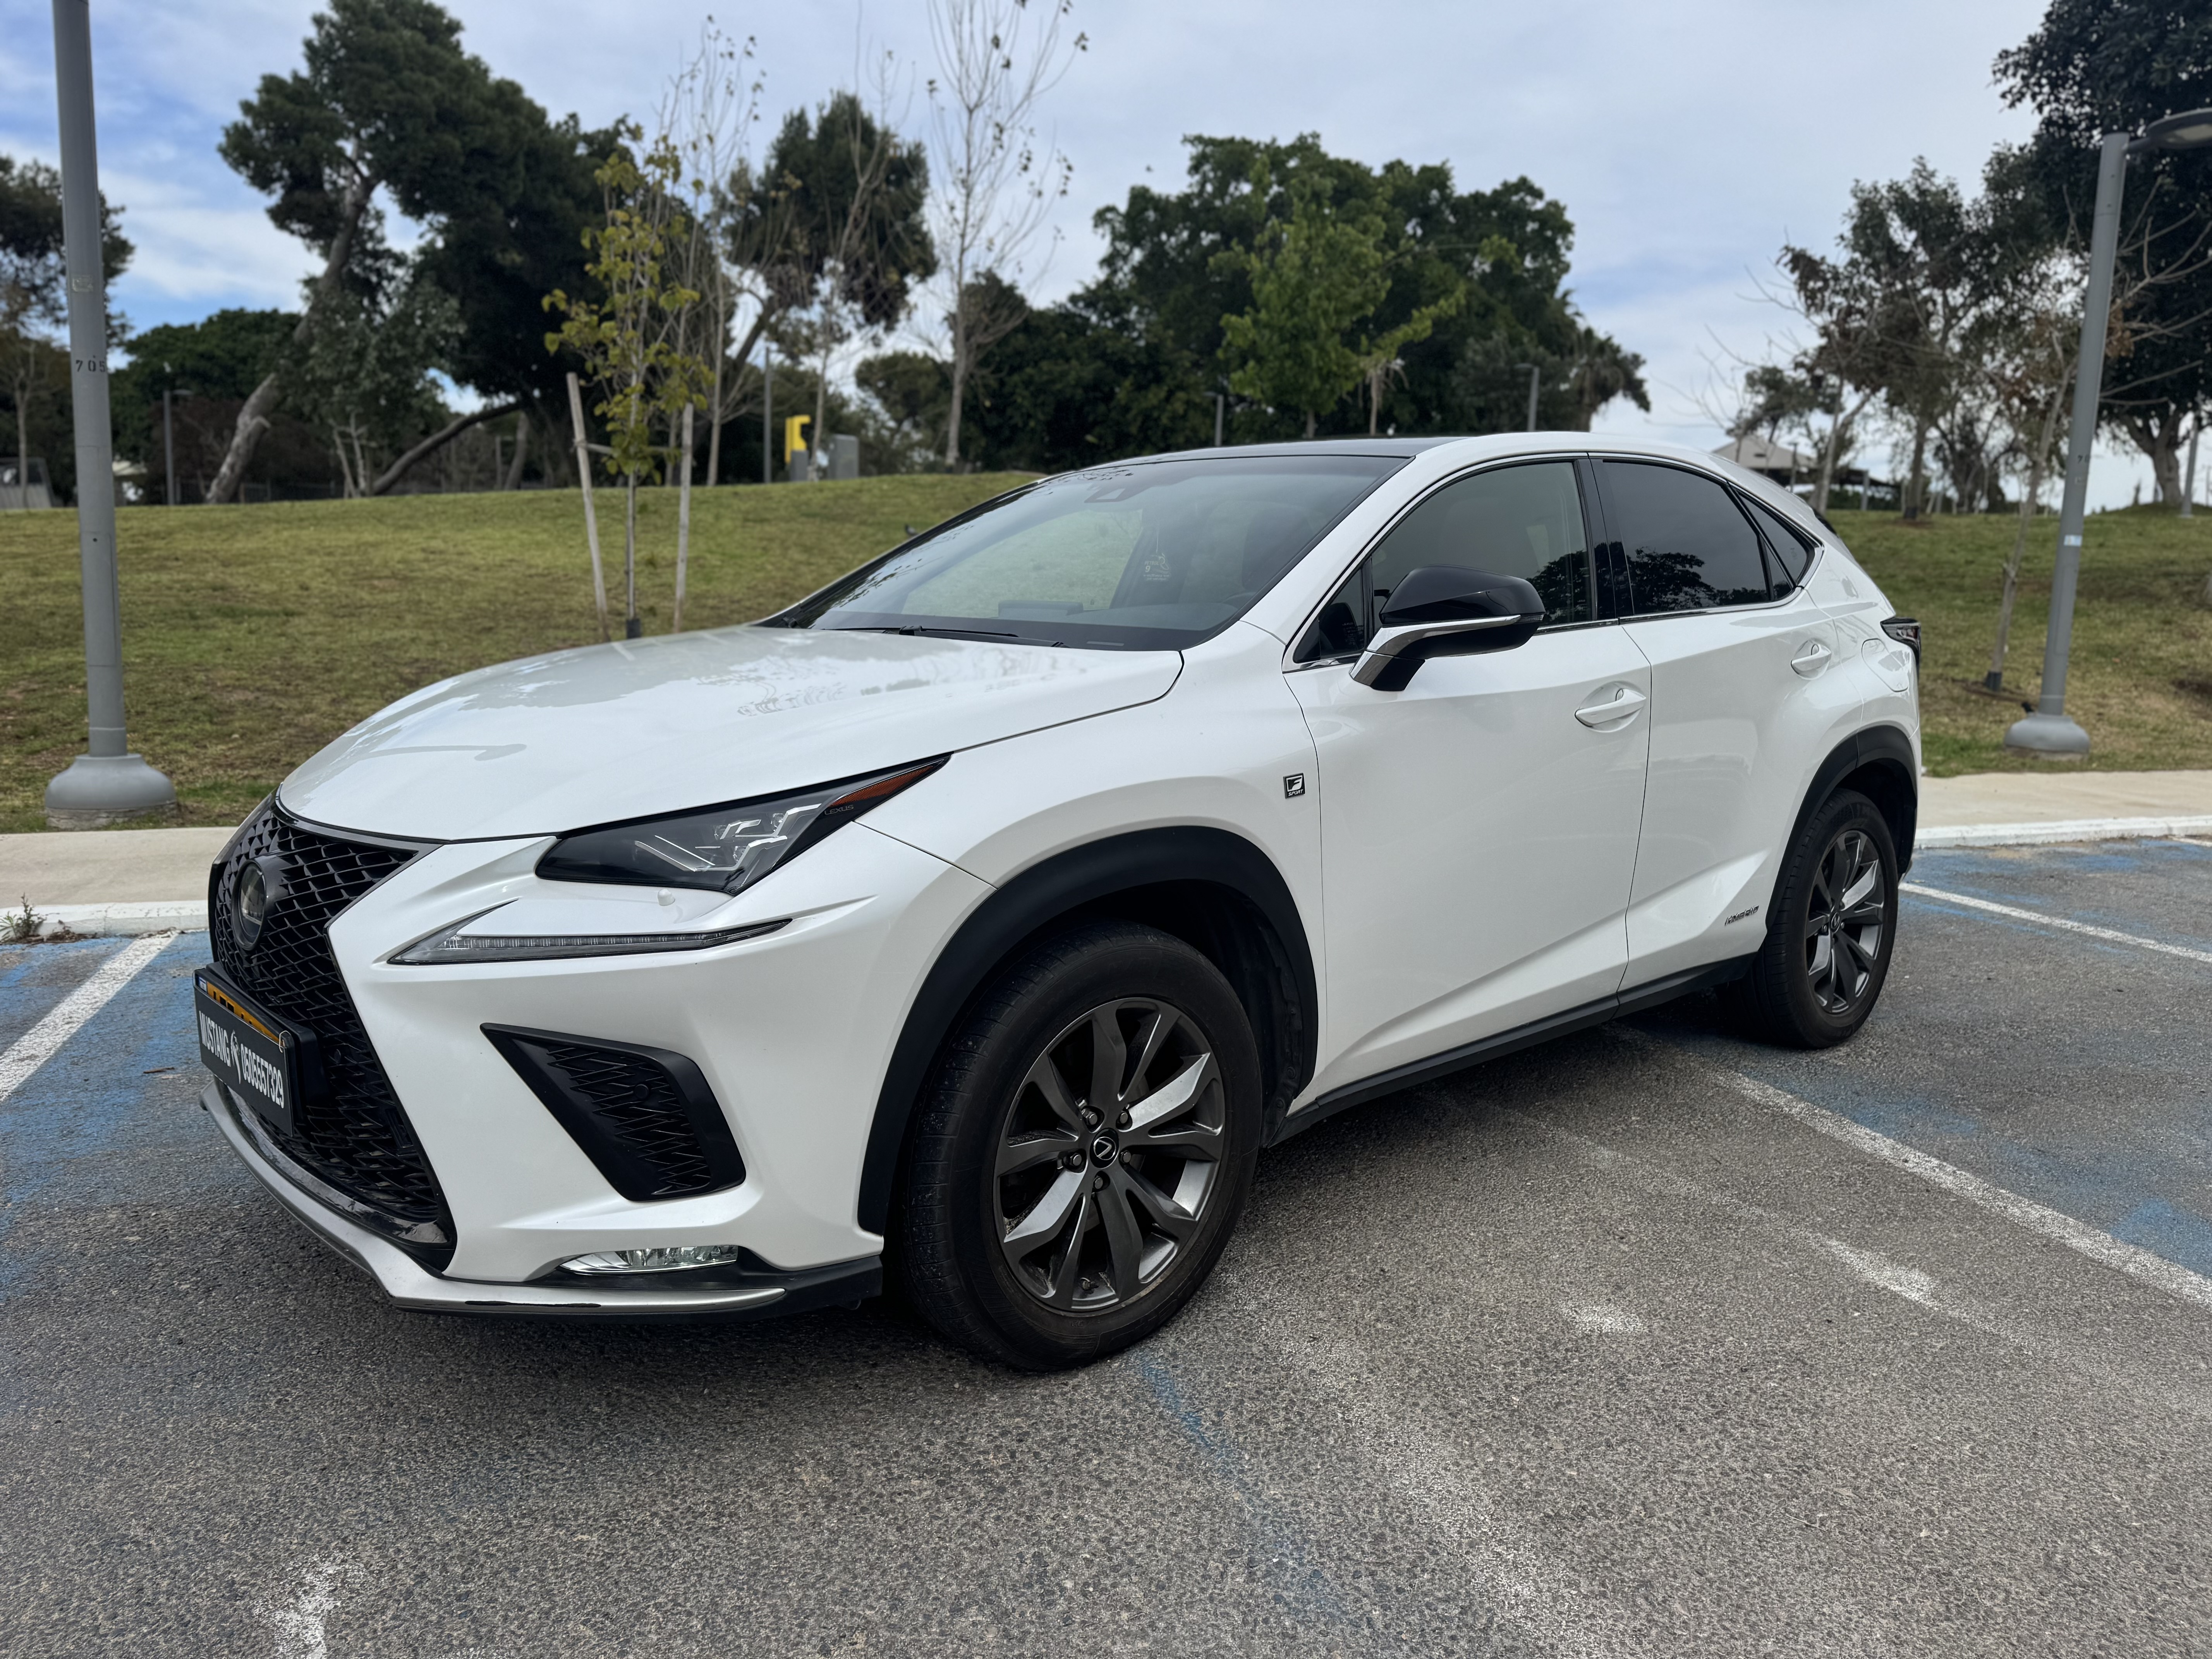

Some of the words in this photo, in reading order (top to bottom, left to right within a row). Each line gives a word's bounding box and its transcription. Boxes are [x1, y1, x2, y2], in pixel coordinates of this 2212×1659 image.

[76, 360, 105, 372] 705
[824, 805, 854, 815] LEXUS
[1724, 905, 1759, 926] HYBRID
[199, 1010, 231, 1066] MUSTANG
[240, 1043, 284, 1108] 0505557329
